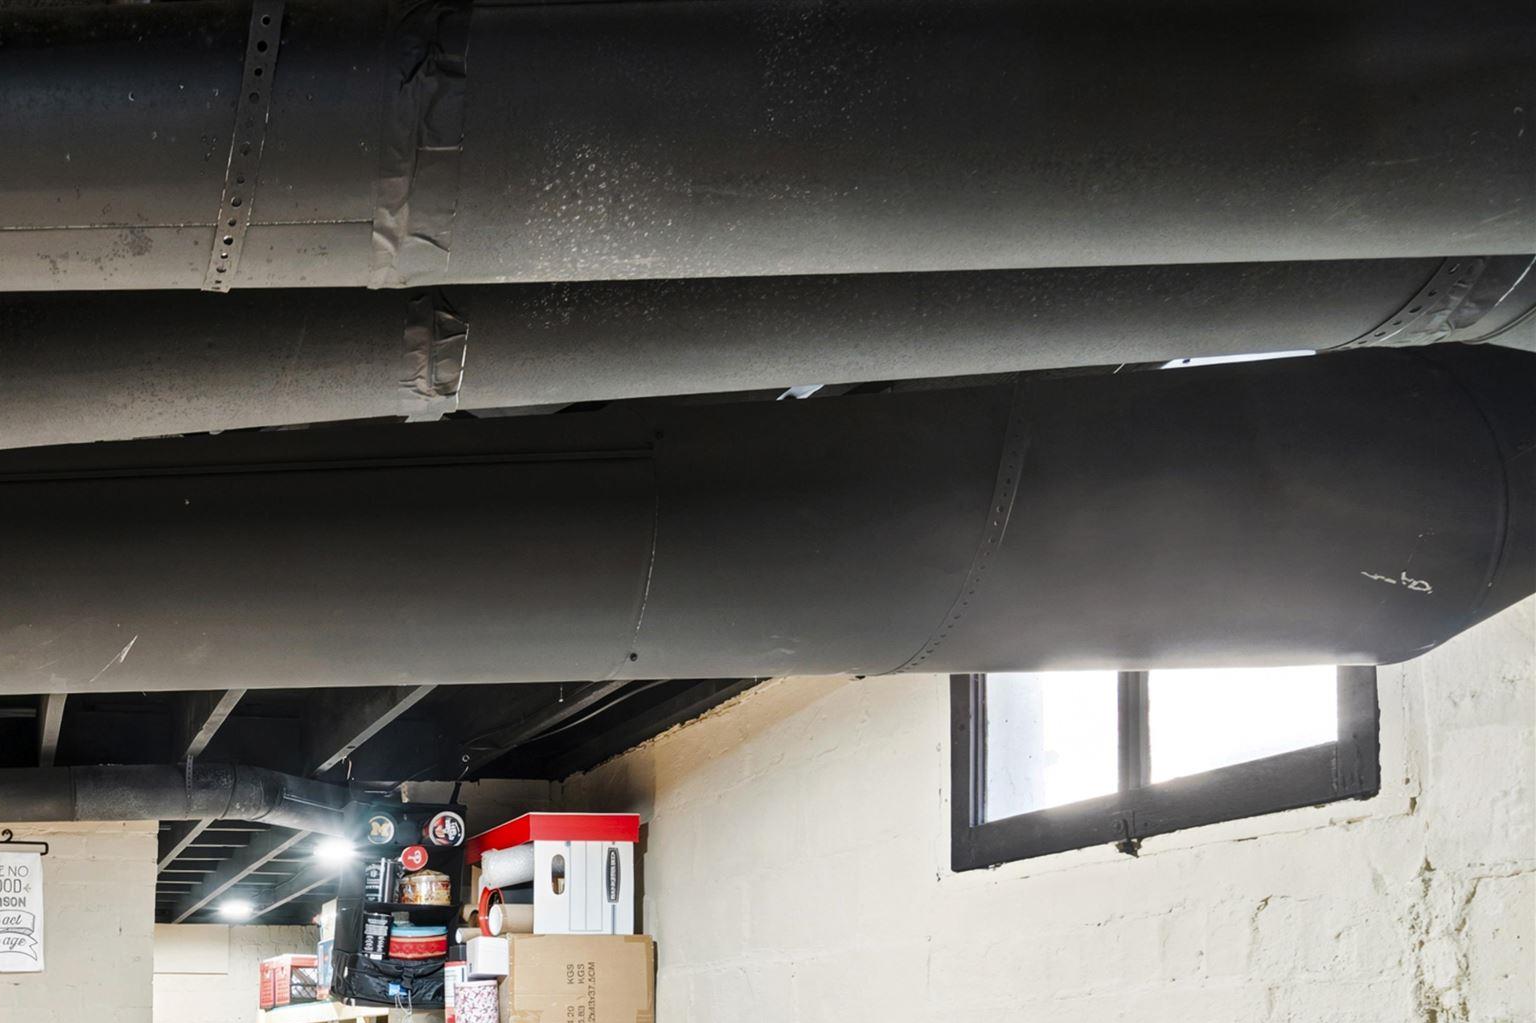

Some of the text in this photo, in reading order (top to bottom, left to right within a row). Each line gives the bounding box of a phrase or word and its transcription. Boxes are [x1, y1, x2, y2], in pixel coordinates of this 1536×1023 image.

[8, 865, 29, 878] NO
[2, 914, 22, 926] act
[2, 936, 27, 953] age
[566, 963, 575, 985] KGS
[577, 963, 585, 984] KGS
